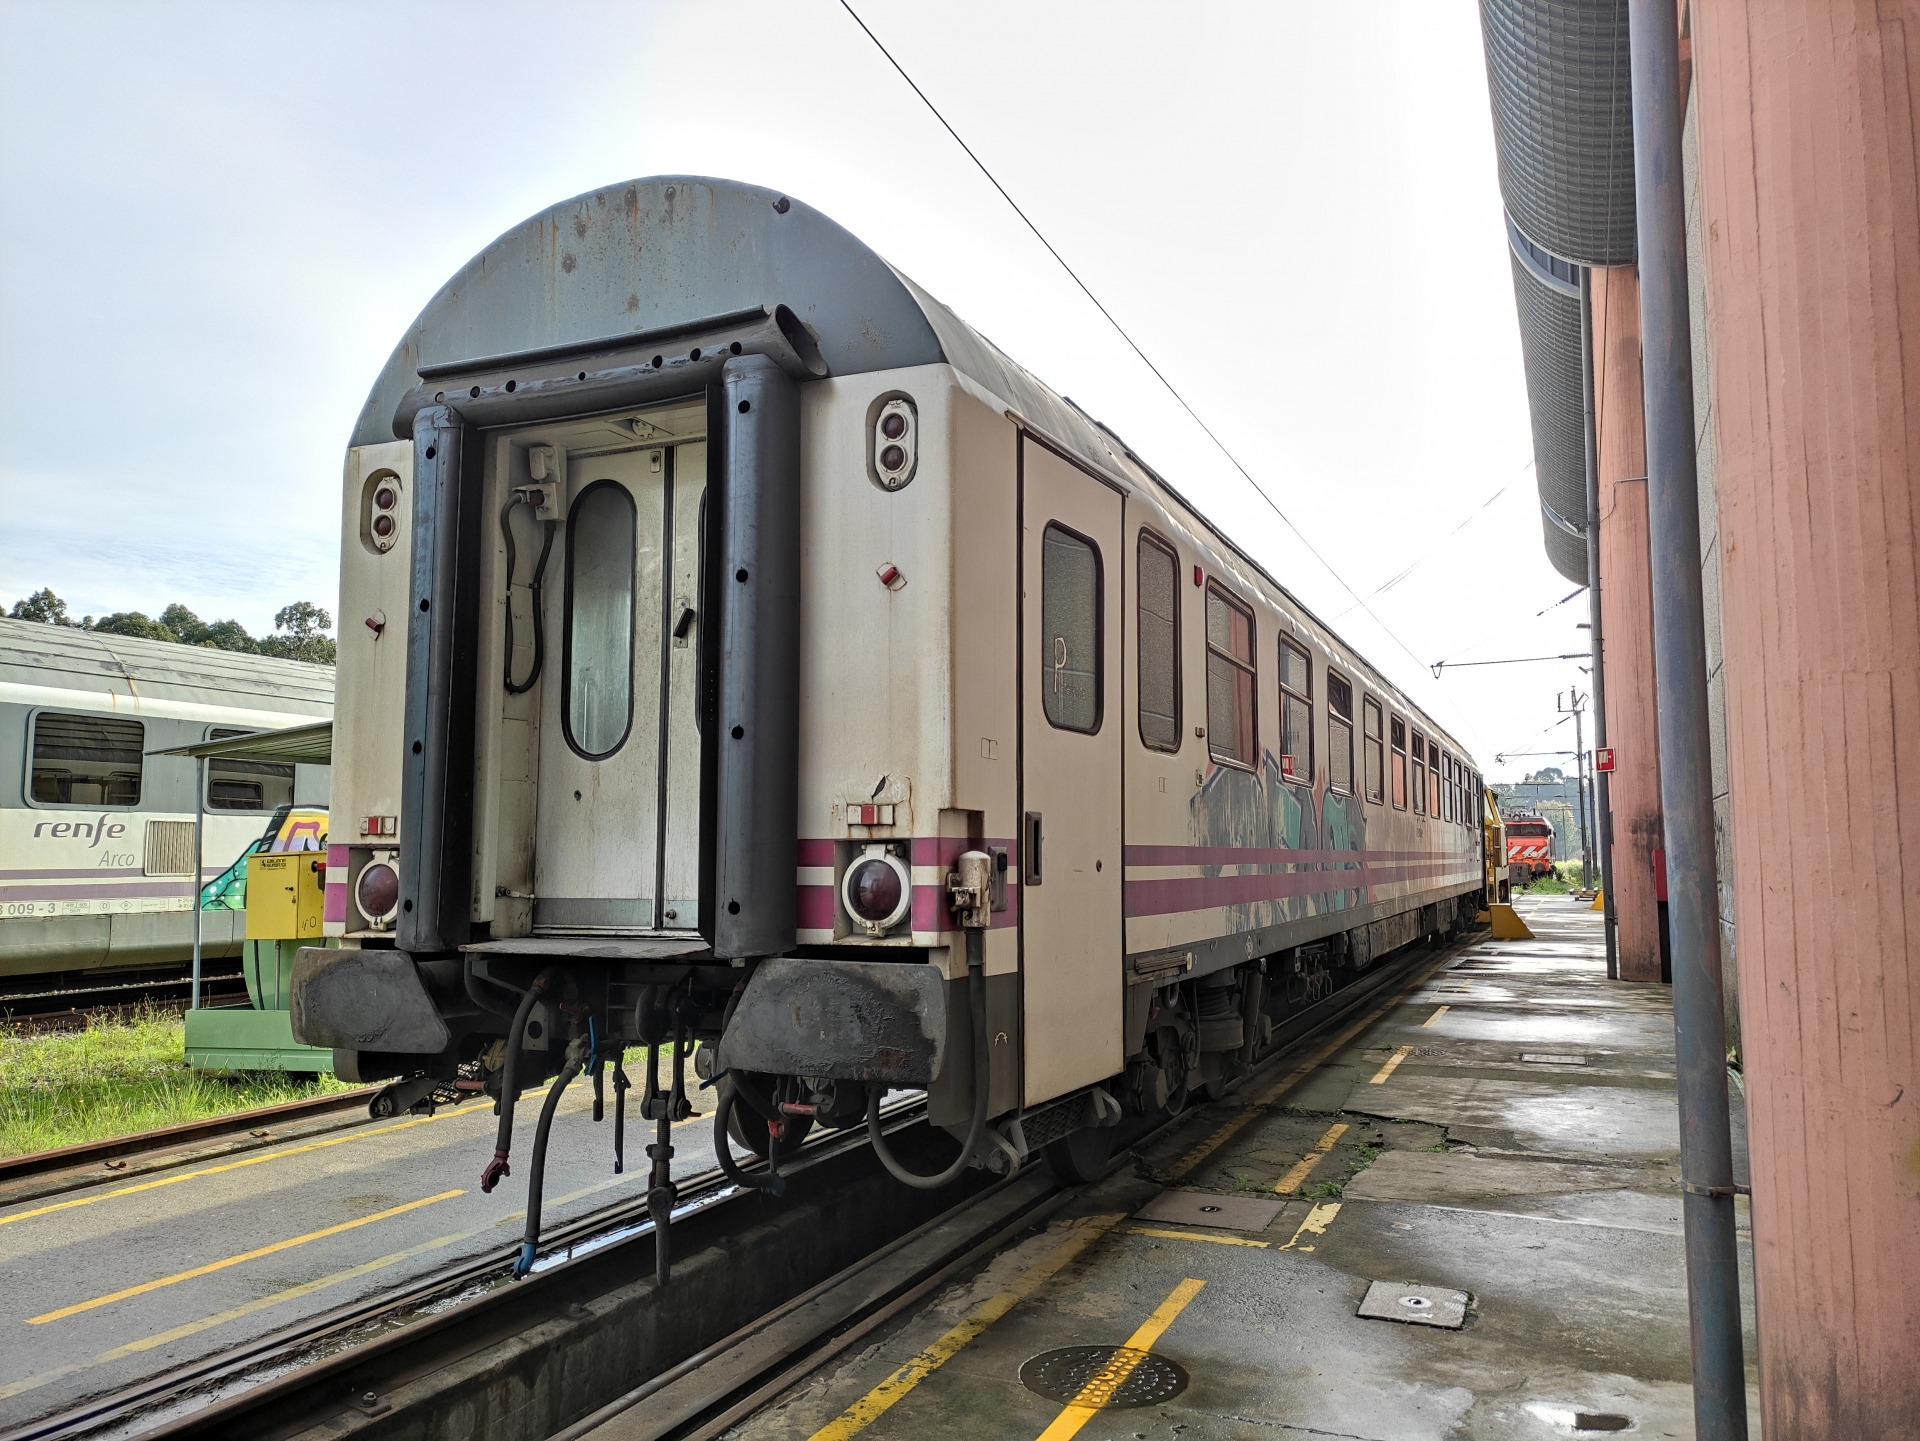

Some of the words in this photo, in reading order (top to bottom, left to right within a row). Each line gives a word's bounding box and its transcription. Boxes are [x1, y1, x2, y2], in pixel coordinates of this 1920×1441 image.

[33, 813, 126, 848] renfe
[98, 850, 135, 867] Arco
[7, 903, 35, 915] 009
[47, 902, 56, 914] 3
